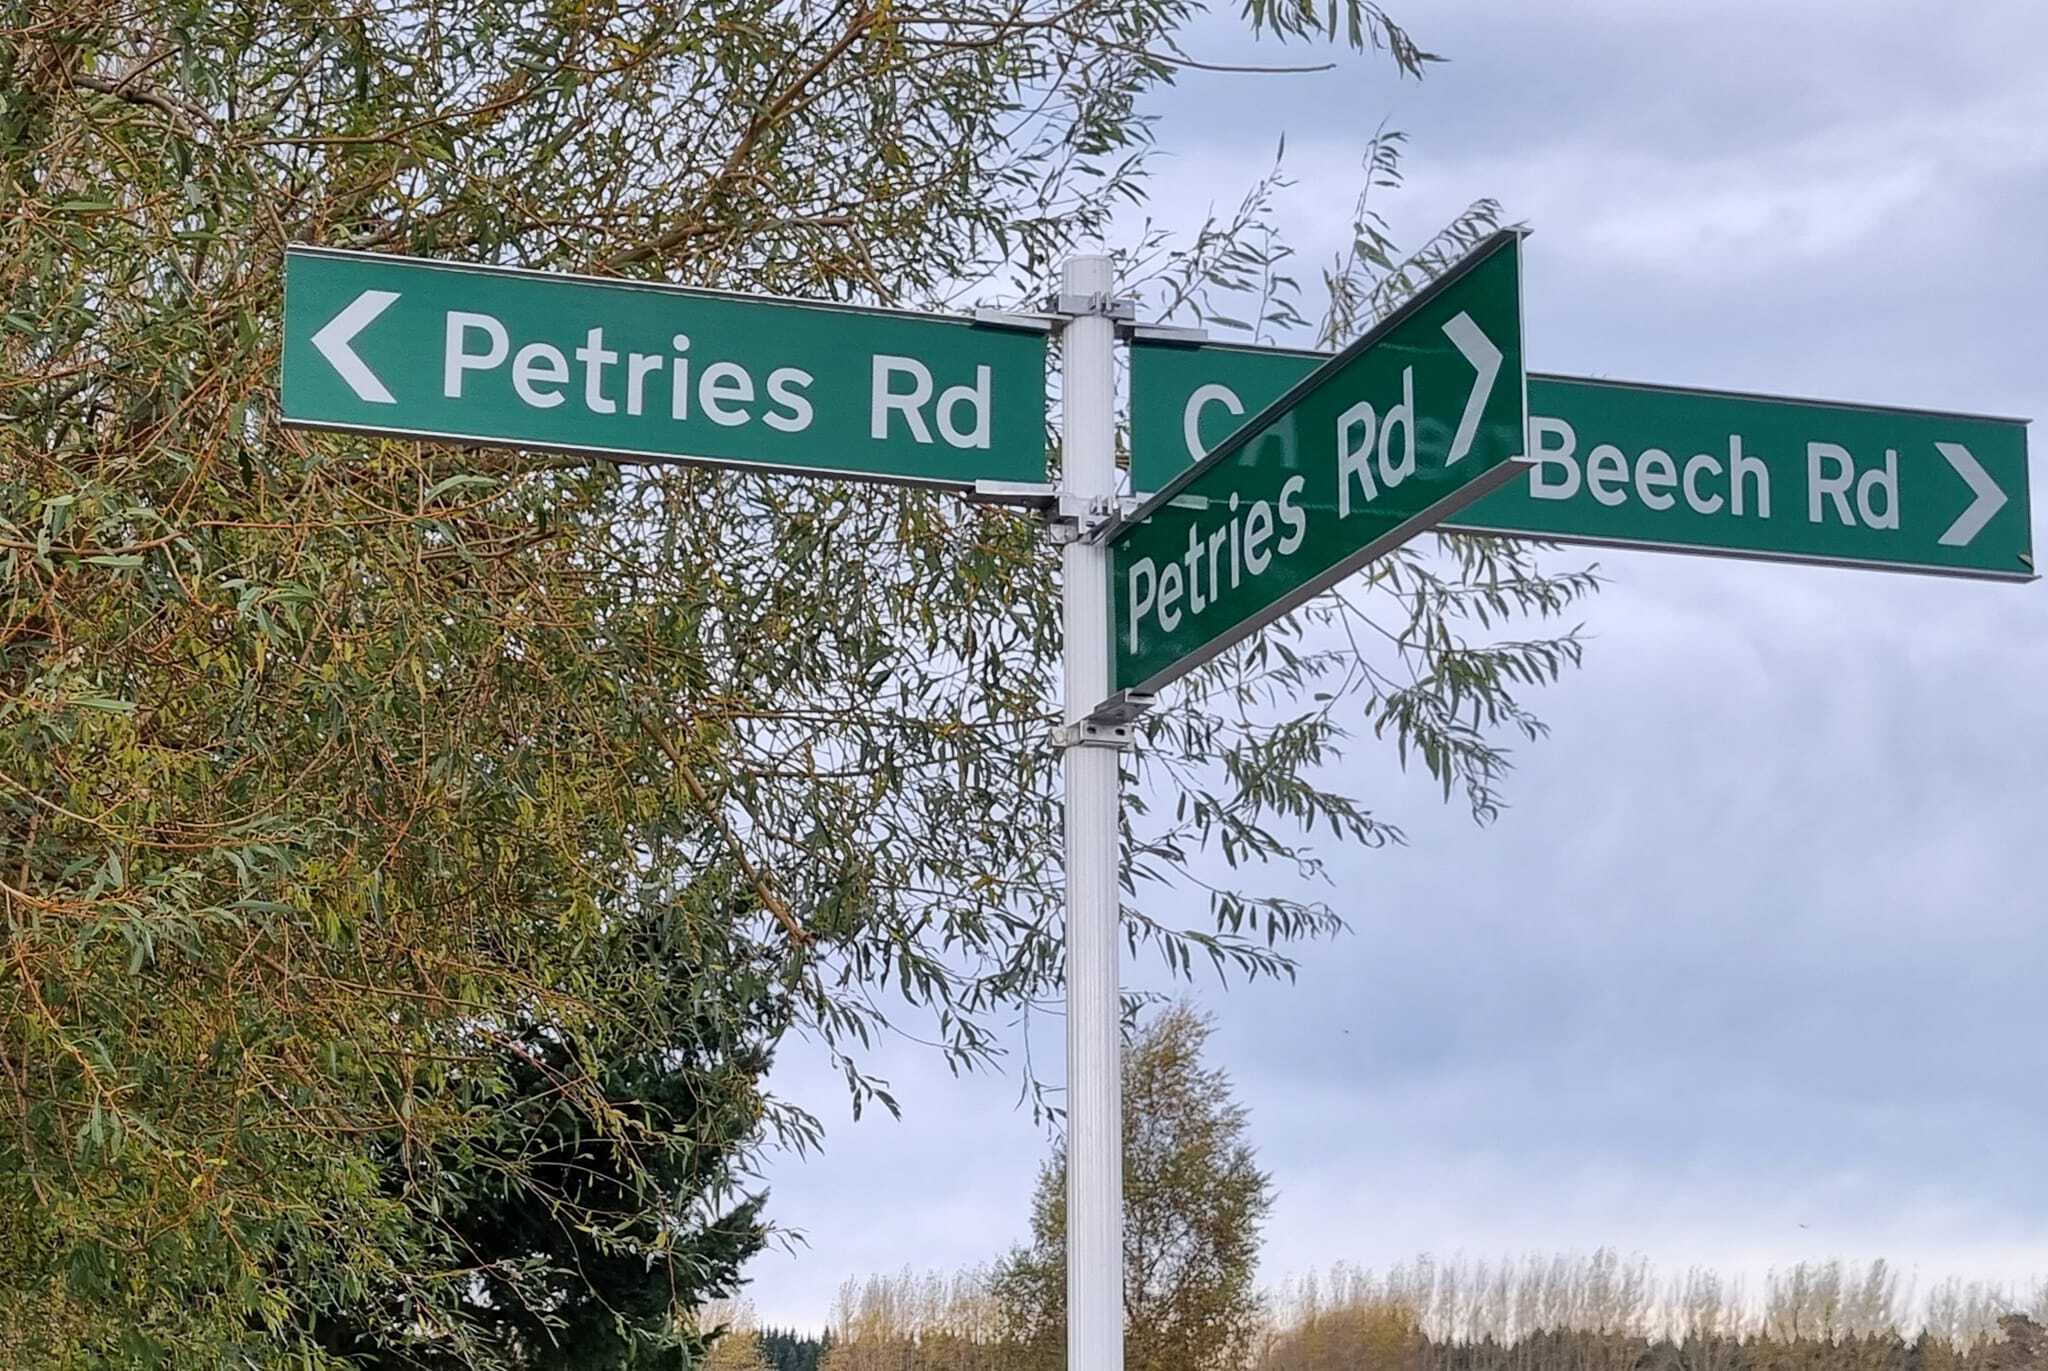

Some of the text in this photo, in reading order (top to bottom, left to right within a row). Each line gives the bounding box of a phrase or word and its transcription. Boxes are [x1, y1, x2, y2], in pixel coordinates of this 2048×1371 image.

[443, 310, 991, 449] Petries Rd
[1129, 475, 1306, 655] Petries
[1337, 365, 1415, 519] Rd
[1529, 415, 1899, 529] Beech Rd
